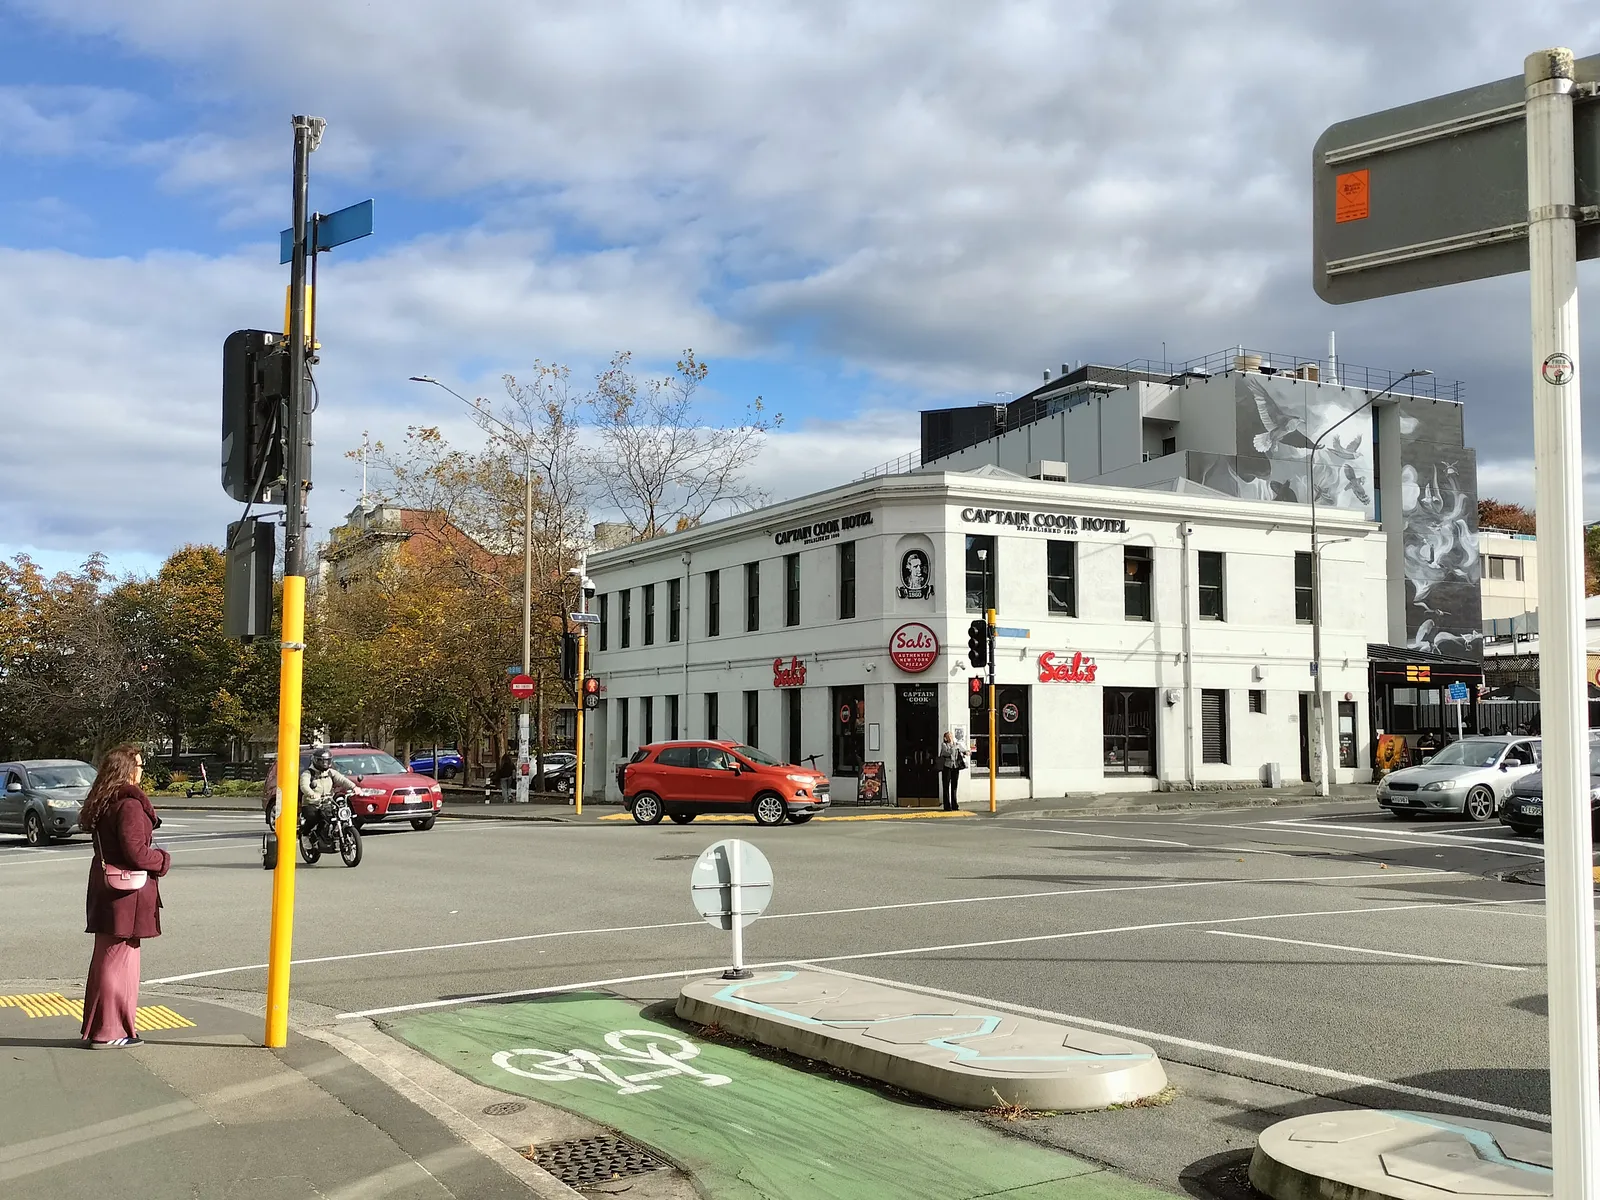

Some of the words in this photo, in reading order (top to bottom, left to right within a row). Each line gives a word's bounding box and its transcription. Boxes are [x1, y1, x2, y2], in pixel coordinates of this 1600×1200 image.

[774, 525, 812, 545] CAPTAIN
[813, 519, 840, 536] COOK
[841, 511, 873, 530] HOTEL
[960, 507, 1030, 526] CAPTAIN
[1032, 513, 1078, 530] COOK
[1080, 517, 1130, 534] HOTEL
[1016, 525, 1061, 534] ESTABLISHED
[896, 631, 932, 649] Sal's
[773, 655, 807, 687] Sal's
[1039, 651, 1098, 683] Sal's
